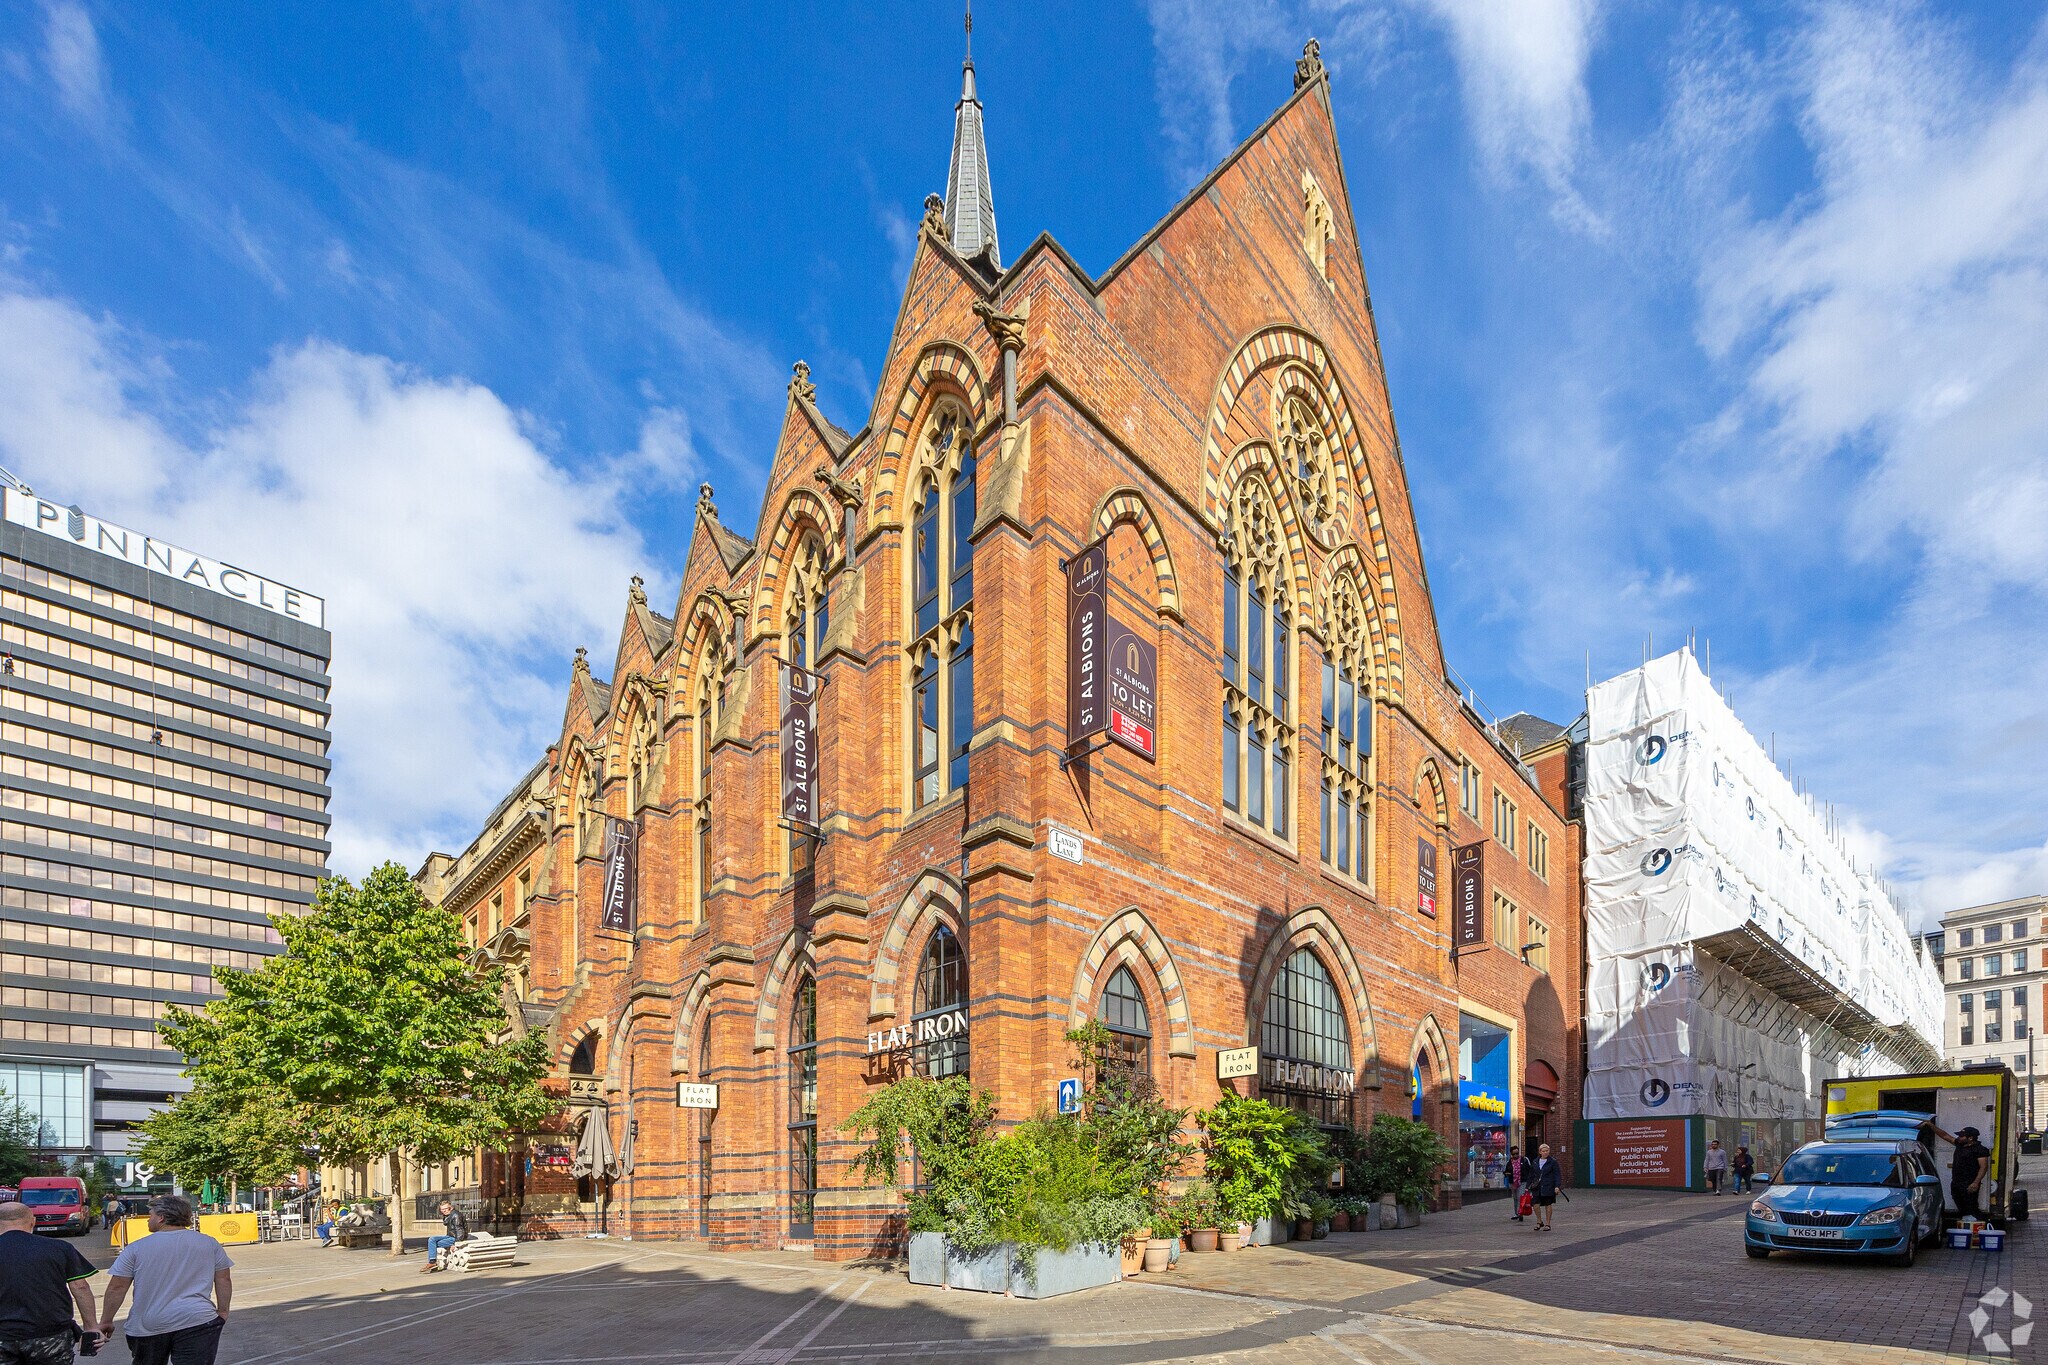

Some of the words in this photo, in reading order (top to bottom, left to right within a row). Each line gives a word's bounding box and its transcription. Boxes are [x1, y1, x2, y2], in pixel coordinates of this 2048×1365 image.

[36, 500, 301, 618] PINNACLE
[1082, 610, 1093, 698] ALBIONS
[1124, 673, 1150, 694] ALBIONS
[1112, 681, 1128, 702] TO
[1132, 694, 1153, 718] LET
[794, 718, 807, 792] ALBIONS
[1055, 832, 1078, 849] LANDS
[1056, 844, 1075, 858] LANE
[614, 855, 625, 909] ALBIONS
[1419, 875, 1425, 886] TO
[1427, 880, 1436, 892] LET
[1465, 878, 1474, 925] ALBIONS
[867, 1024, 912, 1053] FLAT
[918, 1010, 968, 1042] IRON
[1224, 1062, 1252, 1074] IRON
[1225, 1050, 1251, 1062] FLAT
[1276, 1058, 1314, 1085] FLAT
[1318, 1068, 1354, 1092] IRON
[685, 1096, 712, 1105] IRON
[1468, 1092, 1505, 1117] cardfactory
[1792, 1228, 1817, 1237] YK63
[1819, 1230, 1839, 1239] MPF
